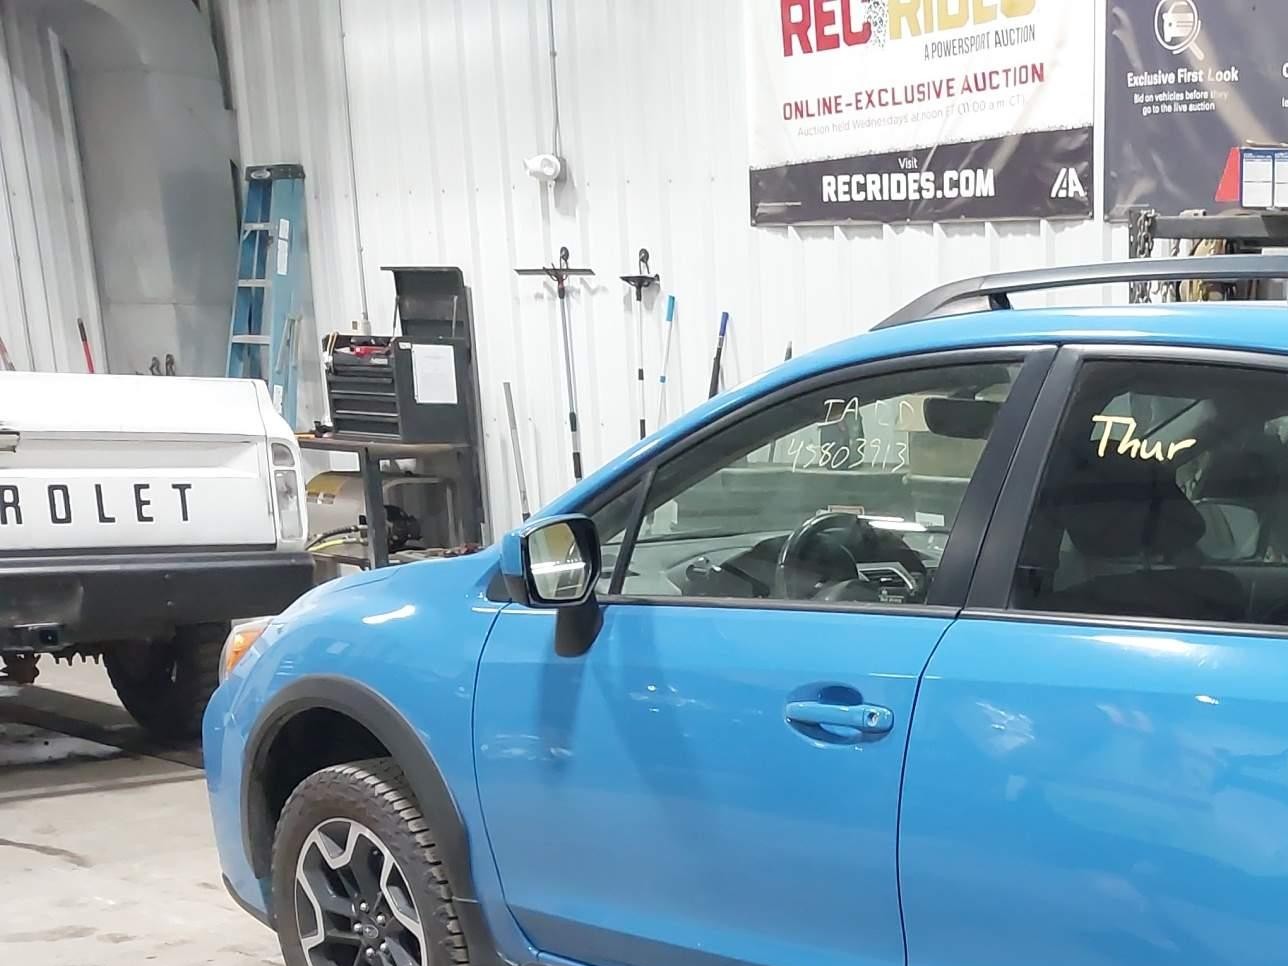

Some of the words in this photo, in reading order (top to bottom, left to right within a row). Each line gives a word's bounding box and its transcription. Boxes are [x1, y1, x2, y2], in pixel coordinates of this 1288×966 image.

[781, 0, 872, 57] REC
[887, 0, 1036, 40] RID
[924, 43, 930, 61] A
[931, 31, 991, 59] POWERSPORT
[994, 23, 1036, 49] AUCTION
[783, 77, 956, 120] ONLINE-EXCLUSIVE
[960, 62, 1045, 95] AUCTION
[1127, 69, 1176, 88] Exclusive
[1177, 67, 1205, 84] First
[1207, 66, 1239, 82] Look
[1133, 93, 1144, 104] Bid
[1144, 94, 1155, 103] on
[1154, 90, 1184, 102] vehicles
[1185, 89, 1209, 100] before
[1142, 105, 1152, 117] go
[1153, 103, 1160, 113] to
[1160, 102, 1172, 113] the
[1173, 101, 1187, 113] live
[1188, 100, 1216, 112] auction
[798, 124, 830, 137] Auction
[852, 113, 909, 130] Wednesdays
[898, 157, 918, 169] Visit
[822, 168, 996, 202] RECRIDES.COM
[788, 437, 907, 472] 45803913
[1092, 414, 1197, 461] Thur
[0, 483, 192, 525] ROLET
